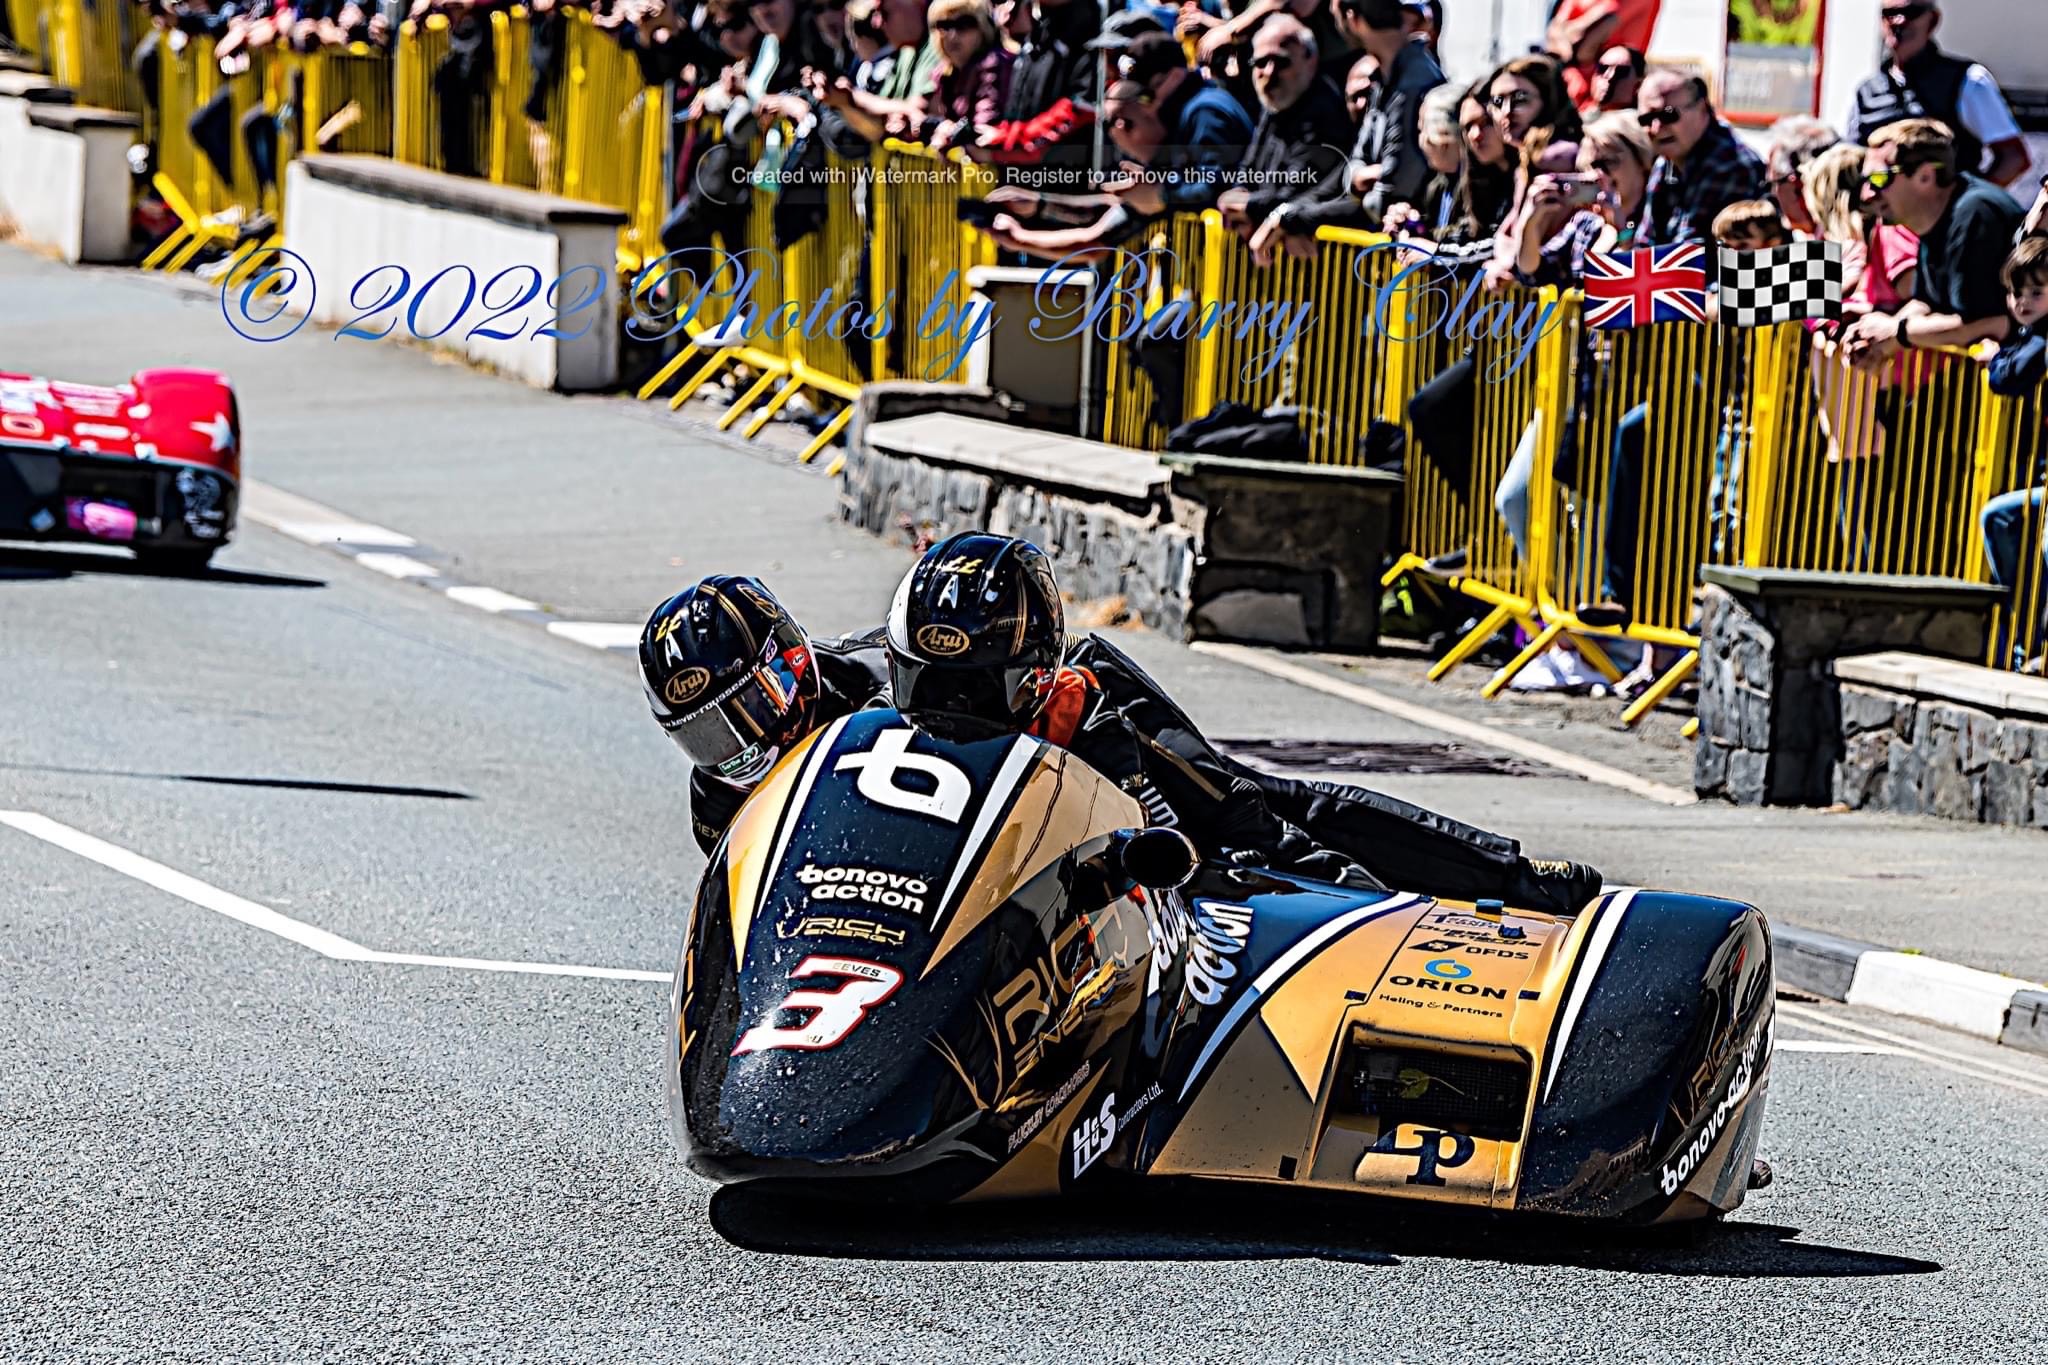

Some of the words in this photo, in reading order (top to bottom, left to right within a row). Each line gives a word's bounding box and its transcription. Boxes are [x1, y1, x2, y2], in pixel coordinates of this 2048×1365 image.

[920, 625, 965, 652] Arai
[669, 670, 706, 699] Arai
[795, 864, 929, 894] bonovo
[811, 884, 925, 914] action
[1464, 946, 1530, 960] DFDS
[1389, 975, 1508, 1000] ORION
[729, 954, 905, 1057] 3
[1443, 1003, 1504, 1018] Partners
[1117, 1094, 1149, 1132] Contractors
[1147, 1081, 1164, 1102] Ltd.
